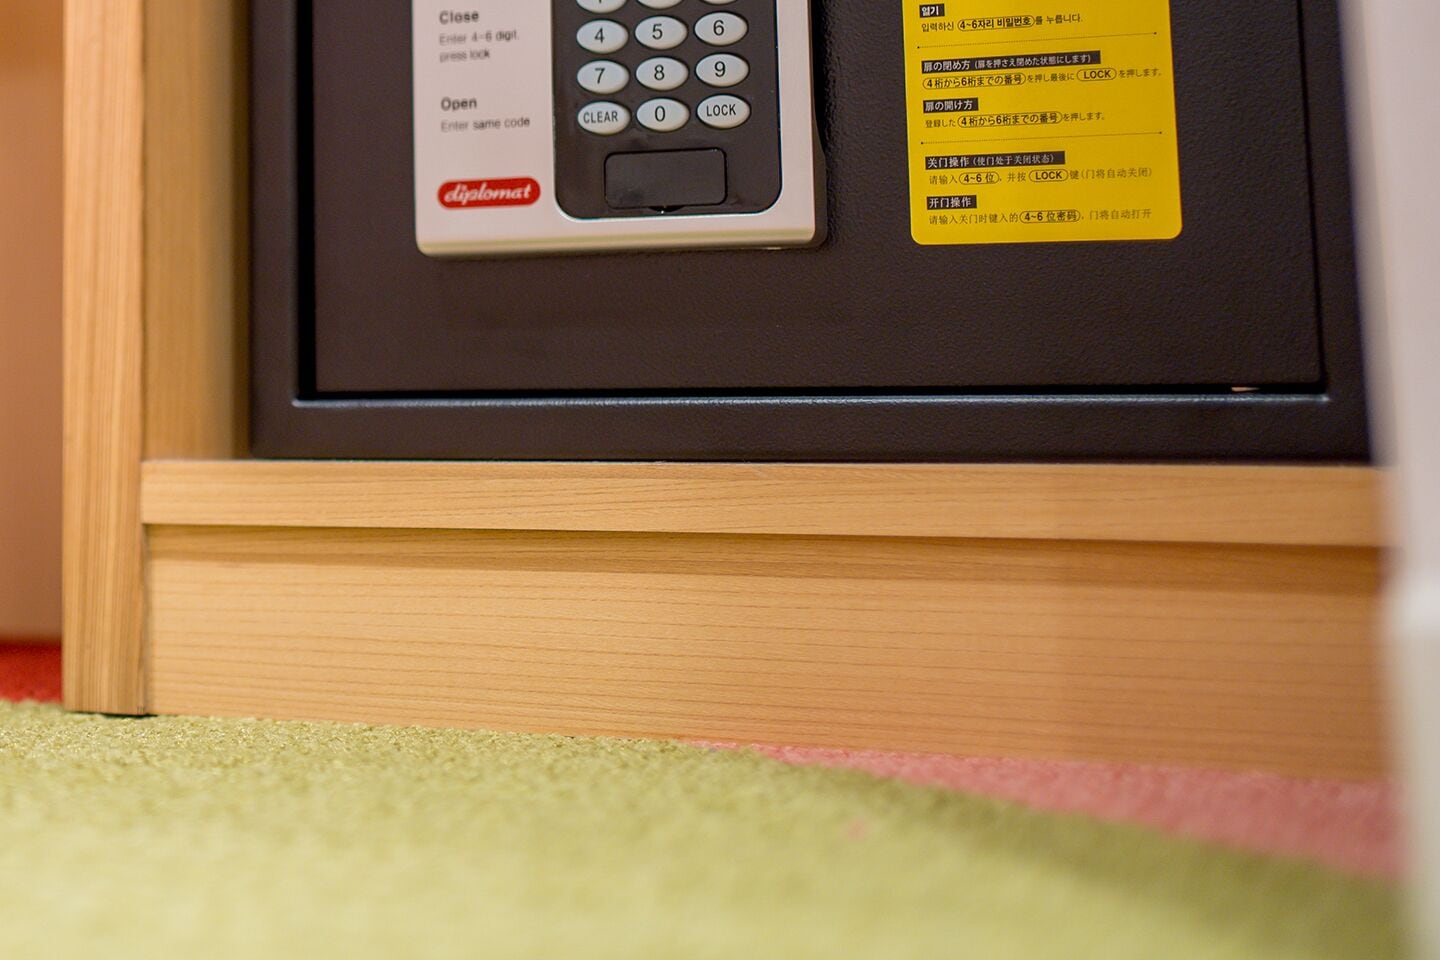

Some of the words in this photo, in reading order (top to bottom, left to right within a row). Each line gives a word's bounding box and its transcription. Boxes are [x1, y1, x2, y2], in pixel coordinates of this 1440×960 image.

[439, 10, 480, 24] Close
[594, 26, 605, 44] 4
[652, 23, 663, 40] 5
[713, 19, 725, 36] 6
[439, 32, 467, 45] Enter
[440, 50, 467, 63] press
[469, 48, 491, 60] lock
[594, 66, 606, 84] 7
[654, 64, 665, 81] 8
[714, 60, 726, 78] 9
[1083, 69, 1111, 80] LOCK
[440, 97, 477, 111] Open
[706, 103, 737, 117] LOCK
[583, 110, 619, 124] CLEAR
[654, 105, 666, 122] 0
[441, 119, 469, 132] Enter
[472, 119, 501, 131] same
[504, 116, 530, 128] code
[1035, 169, 1063, 181] LOCK
[443, 181, 533, 206] diplomat
[928, 196, 972, 209] 开门操作
